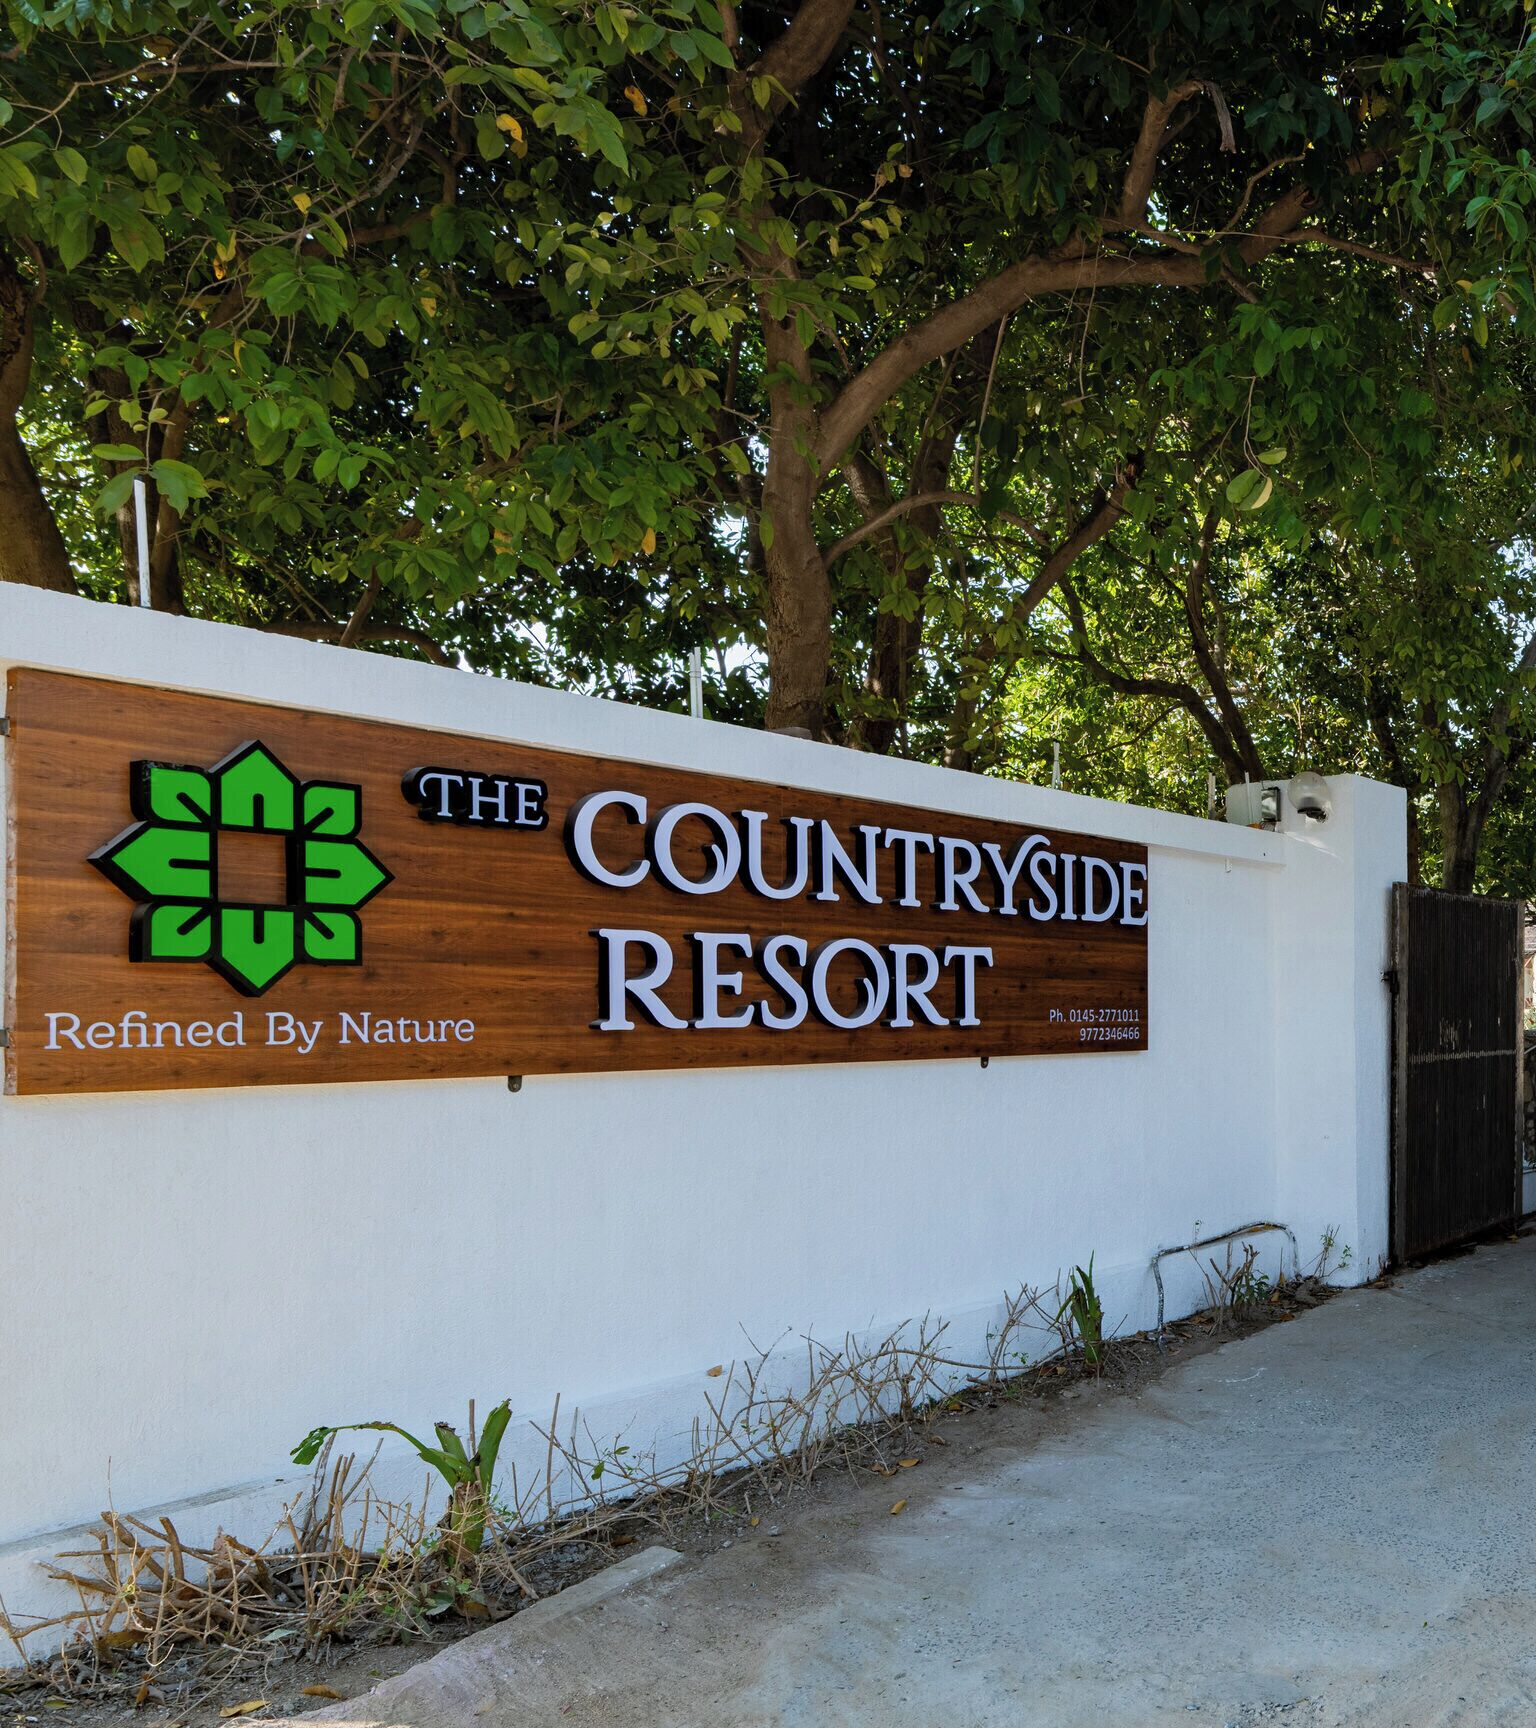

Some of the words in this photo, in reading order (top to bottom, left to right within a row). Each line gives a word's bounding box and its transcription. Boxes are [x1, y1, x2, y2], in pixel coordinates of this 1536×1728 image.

[419, 772, 543, 826] THE
[572, 790, 1148, 926] COUNTRYSIDE
[599, 928, 994, 1031] RESORT
[44, 1010, 246, 1050] Refined
[265, 1011, 324, 1054] By
[338, 1012, 475, 1044] Nature
[1049, 1009, 1067, 1022] Ph.
[1069, 1009, 1139, 1022] 0145-2771011
[1080, 1027, 1140, 1041] 9772346466
